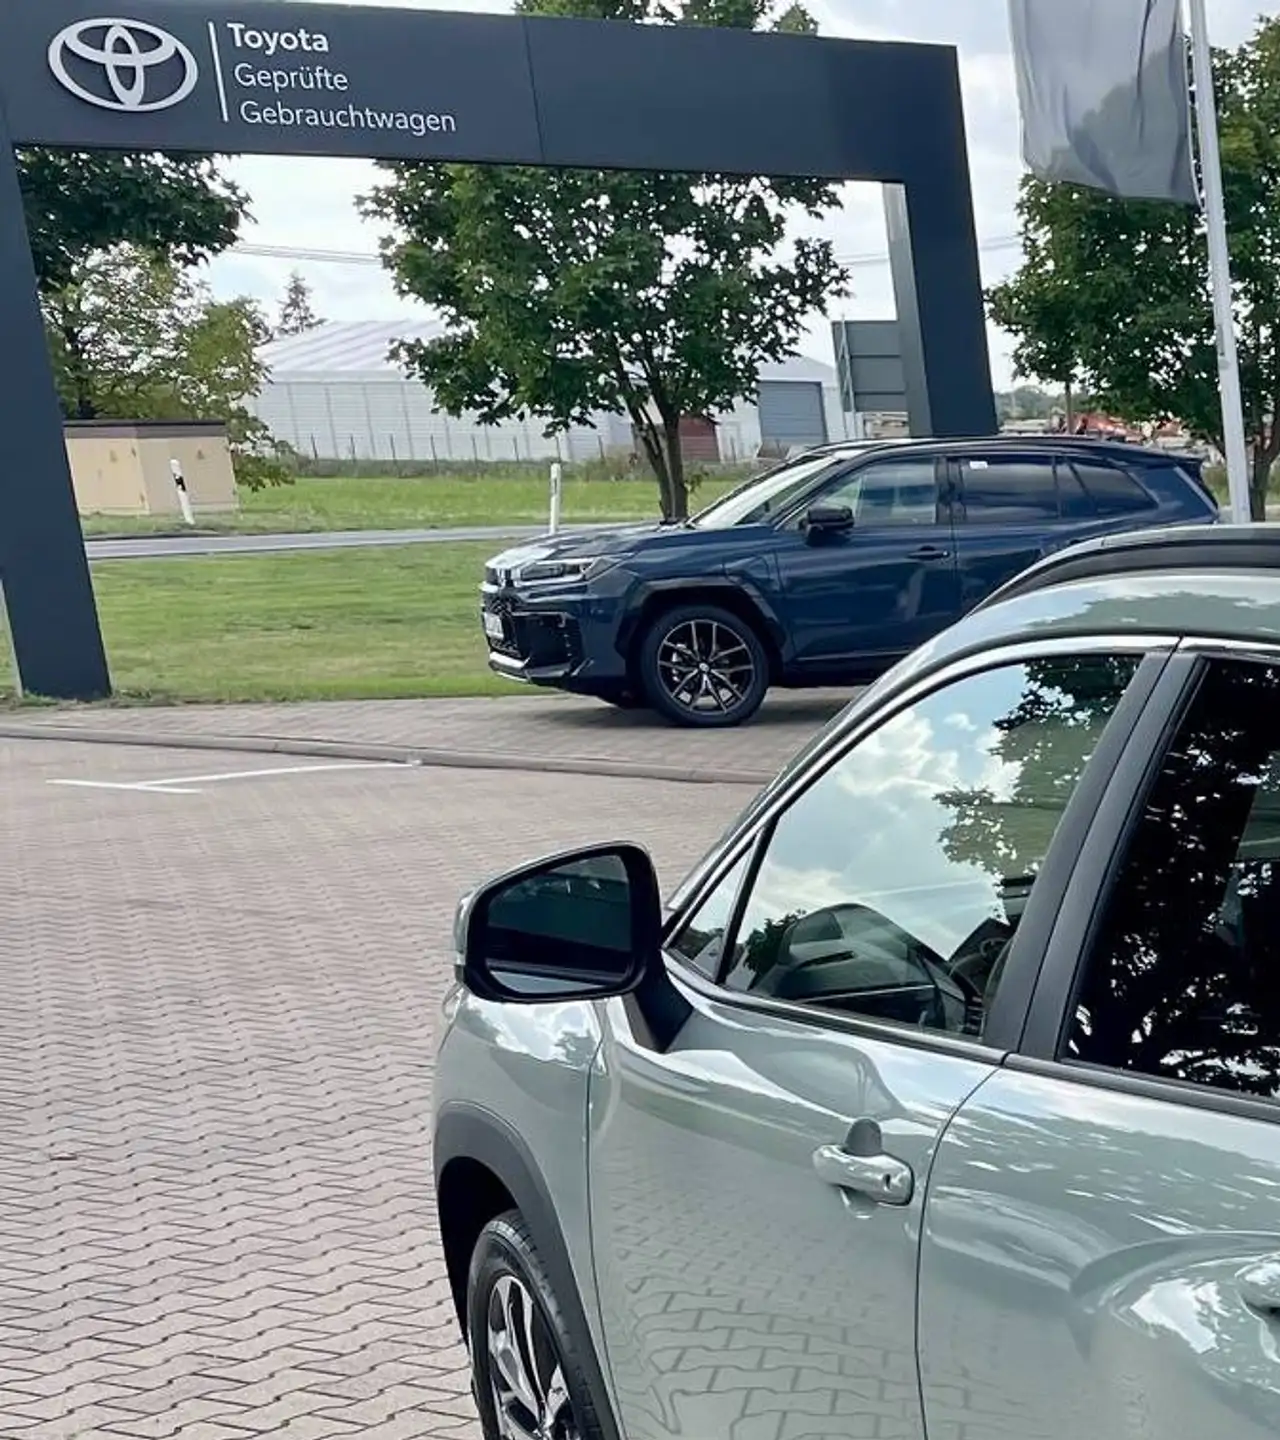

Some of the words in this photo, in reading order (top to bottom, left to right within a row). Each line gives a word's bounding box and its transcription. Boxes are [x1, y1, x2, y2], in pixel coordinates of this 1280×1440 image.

[227, 22, 329, 55] Toyota
[234, 63, 349, 93] Geprüfte
[240, 101, 456, 136] Gebrauchtwagen
